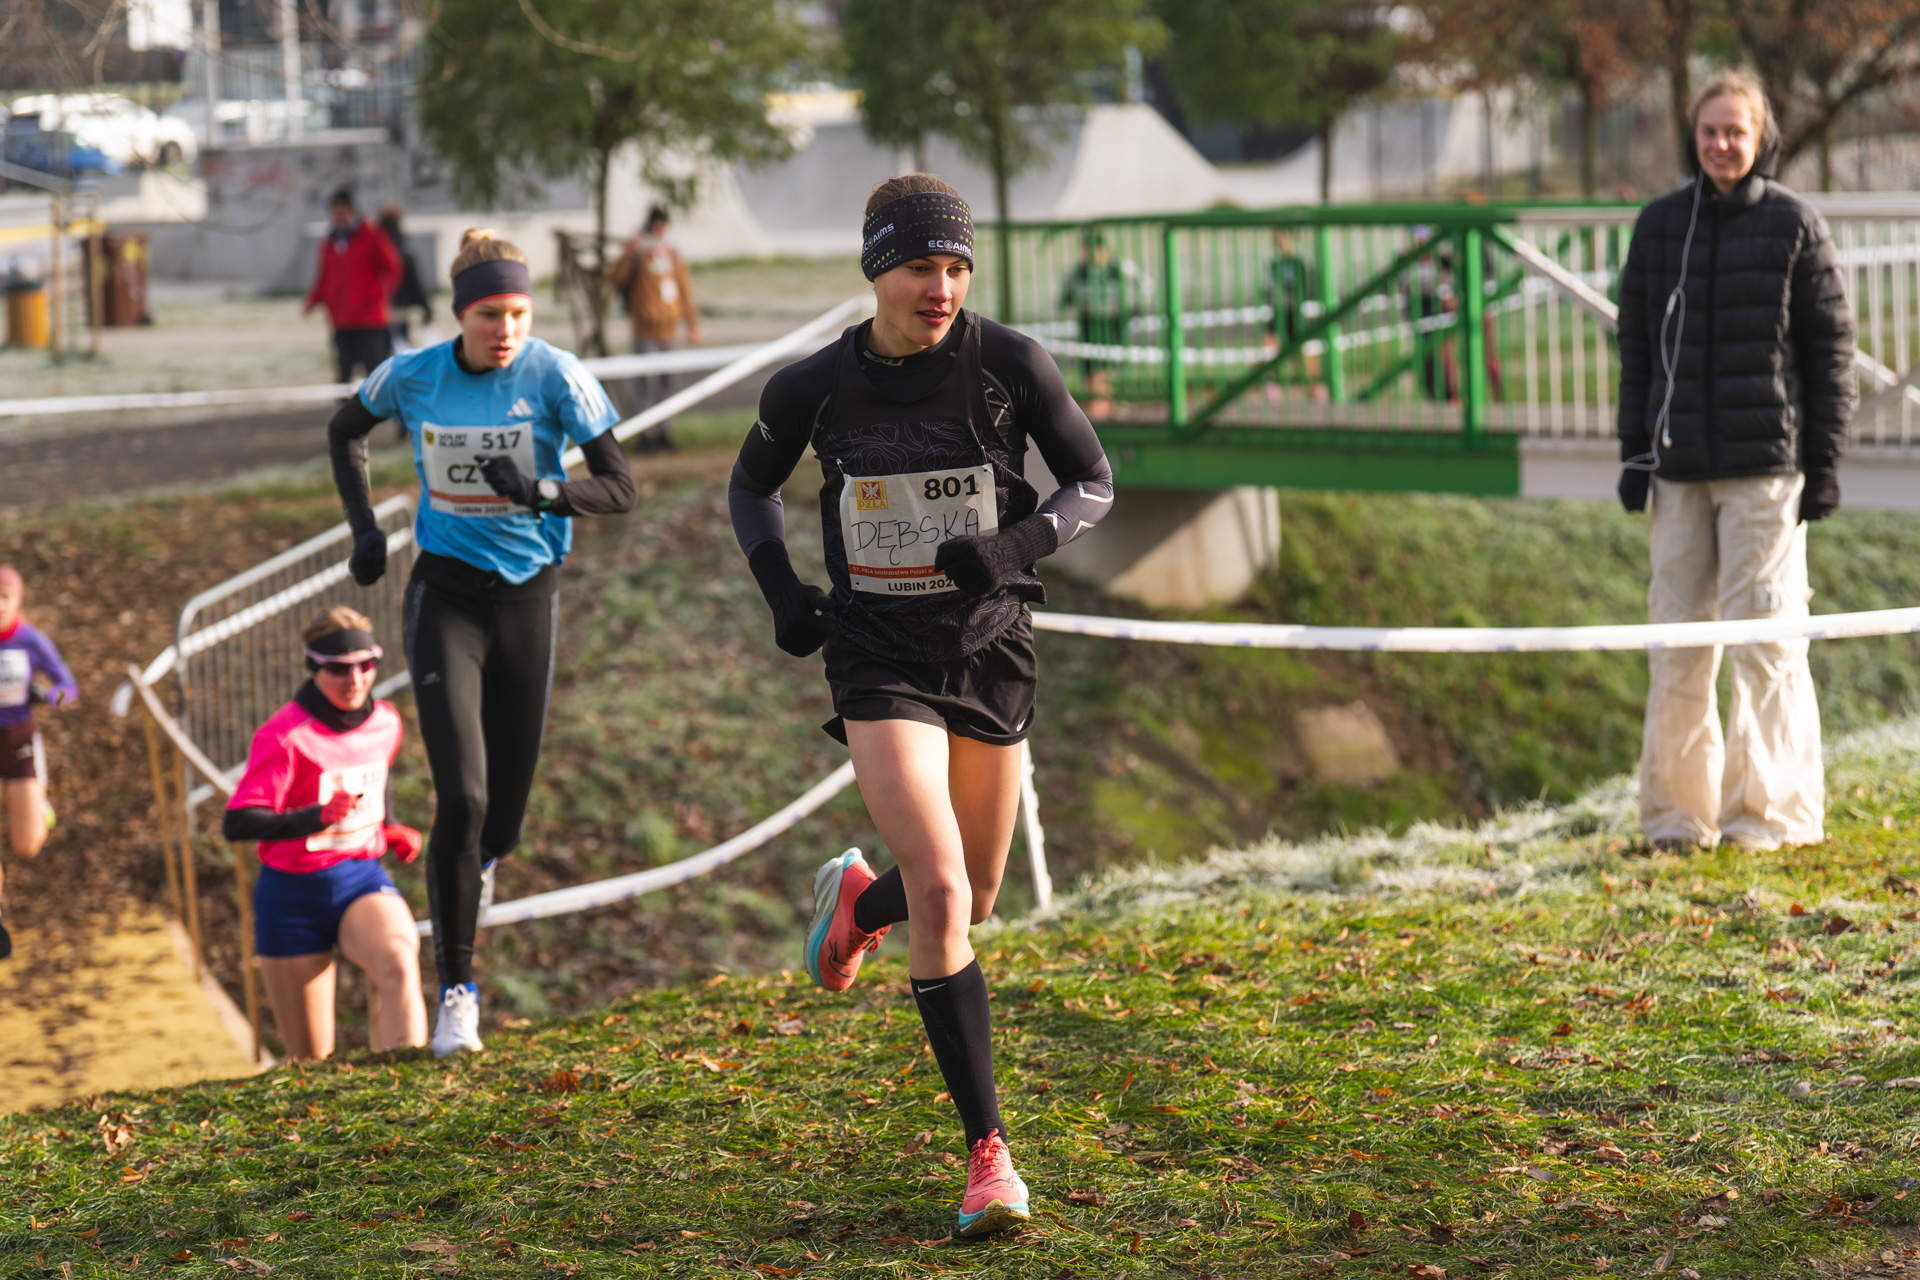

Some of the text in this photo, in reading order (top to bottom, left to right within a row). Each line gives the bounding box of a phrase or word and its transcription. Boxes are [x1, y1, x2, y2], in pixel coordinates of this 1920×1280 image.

[482, 430, 521, 449] 517
[446, 464, 478, 484] CZ
[924, 474, 980, 500] 801
[851, 508, 979, 566] DĘBSKA
[887, 578, 954, 592] LUBIN 202
